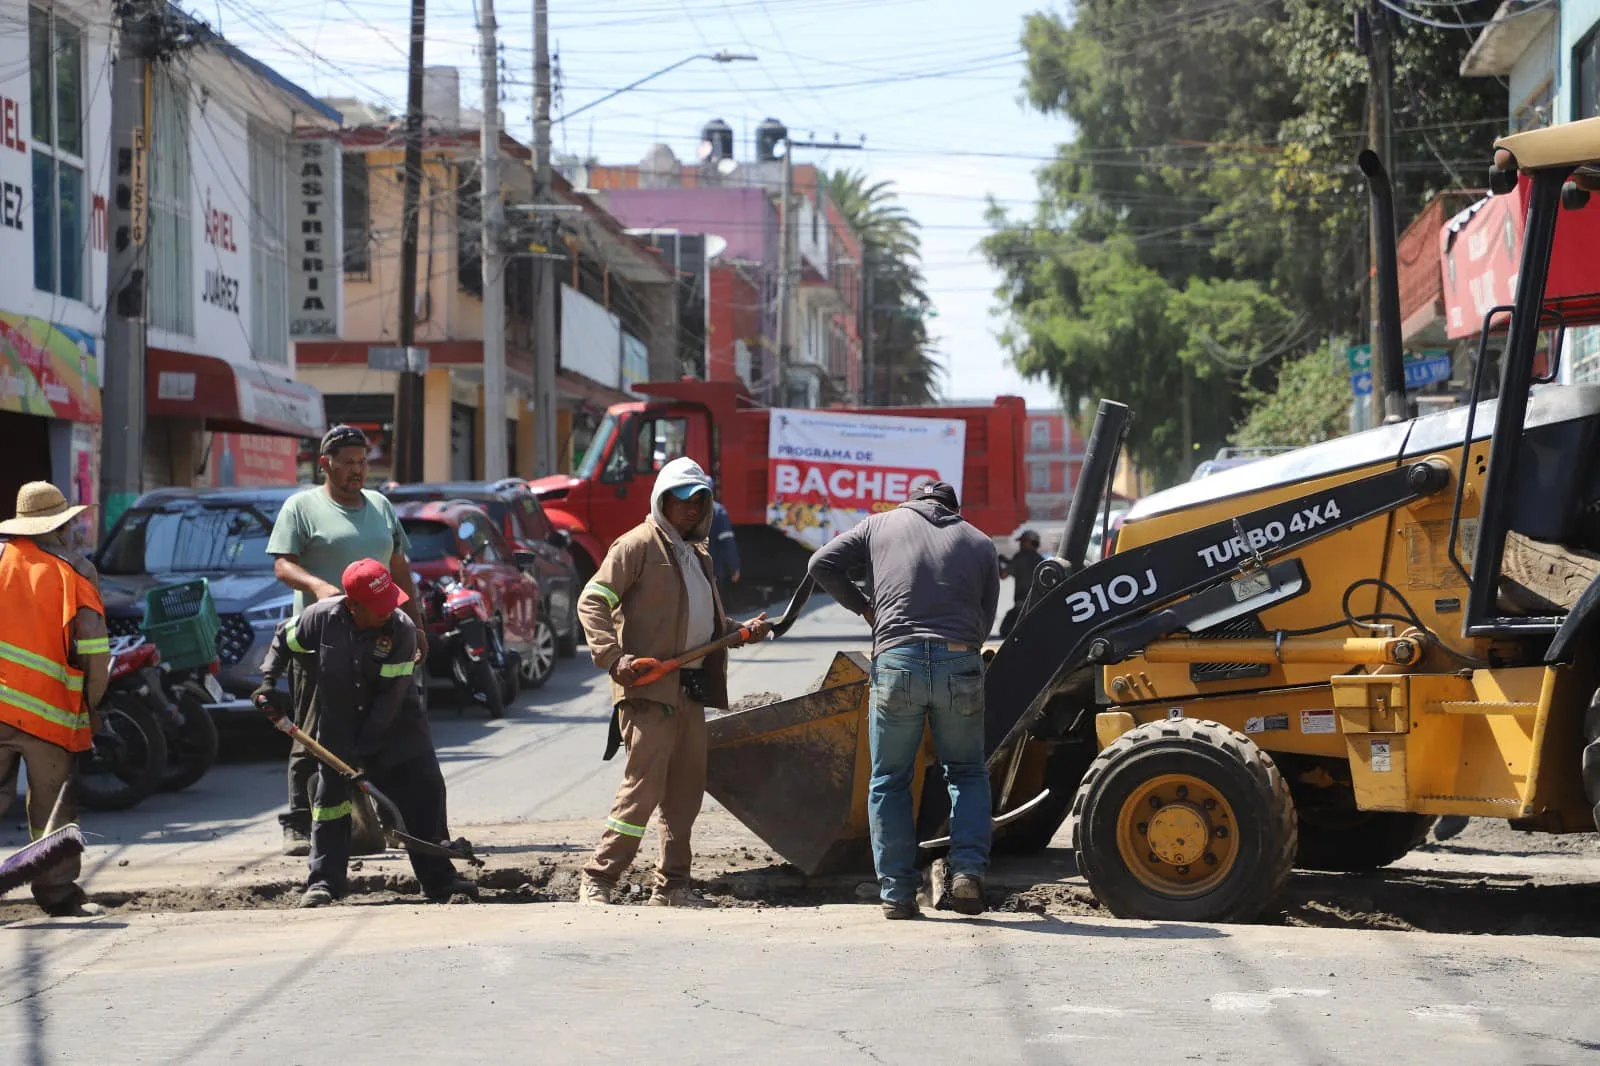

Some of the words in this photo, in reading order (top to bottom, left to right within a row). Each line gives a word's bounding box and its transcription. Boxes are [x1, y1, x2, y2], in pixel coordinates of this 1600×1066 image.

[302, 142, 325, 310] SASTRERIA
[777, 445, 851, 460] PROGRAMA
[855, 451, 873, 461] DE
[1198, 521, 1286, 568] TURBO
[1289, 499, 1342, 533] 4X4
[1065, 569, 1158, 623] 310J
